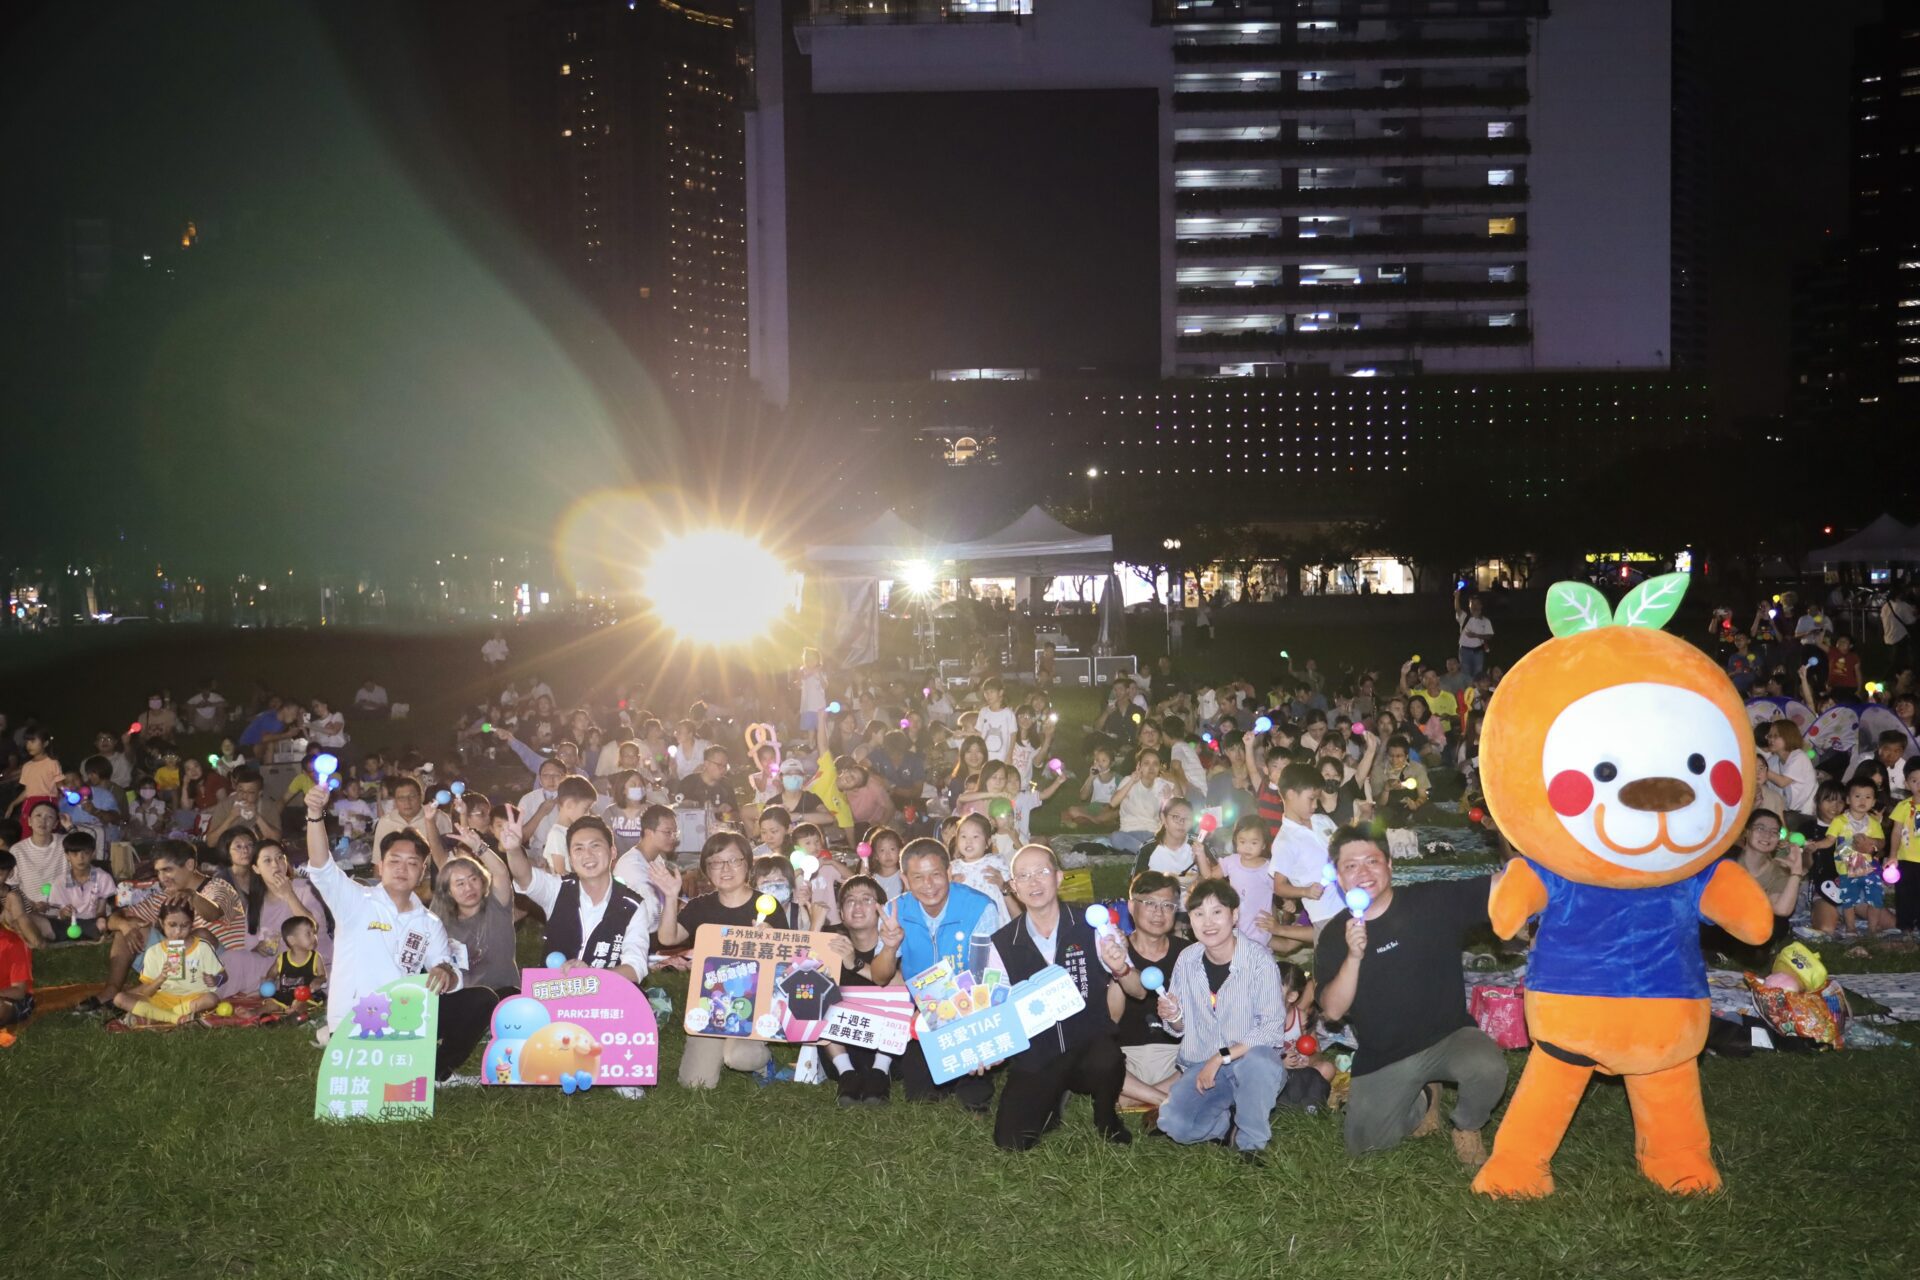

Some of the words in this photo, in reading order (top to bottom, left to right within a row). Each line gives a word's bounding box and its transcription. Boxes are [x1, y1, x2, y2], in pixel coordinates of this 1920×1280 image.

[533, 976, 599, 999] 萌獸現身
[837, 1011, 871, 1029] 十週年
[600, 1032, 656, 1045] 09.01
[828, 1023, 875, 1044] 慶典套票
[937, 1012, 1003, 1051] 我愛TIAF
[331, 1048, 384, 1070] 9/20
[941, 1031, 1015, 1073] 早鳥套票
[600, 1064, 655, 1078] 10.31
[329, 1076, 371, 1095] 開放
